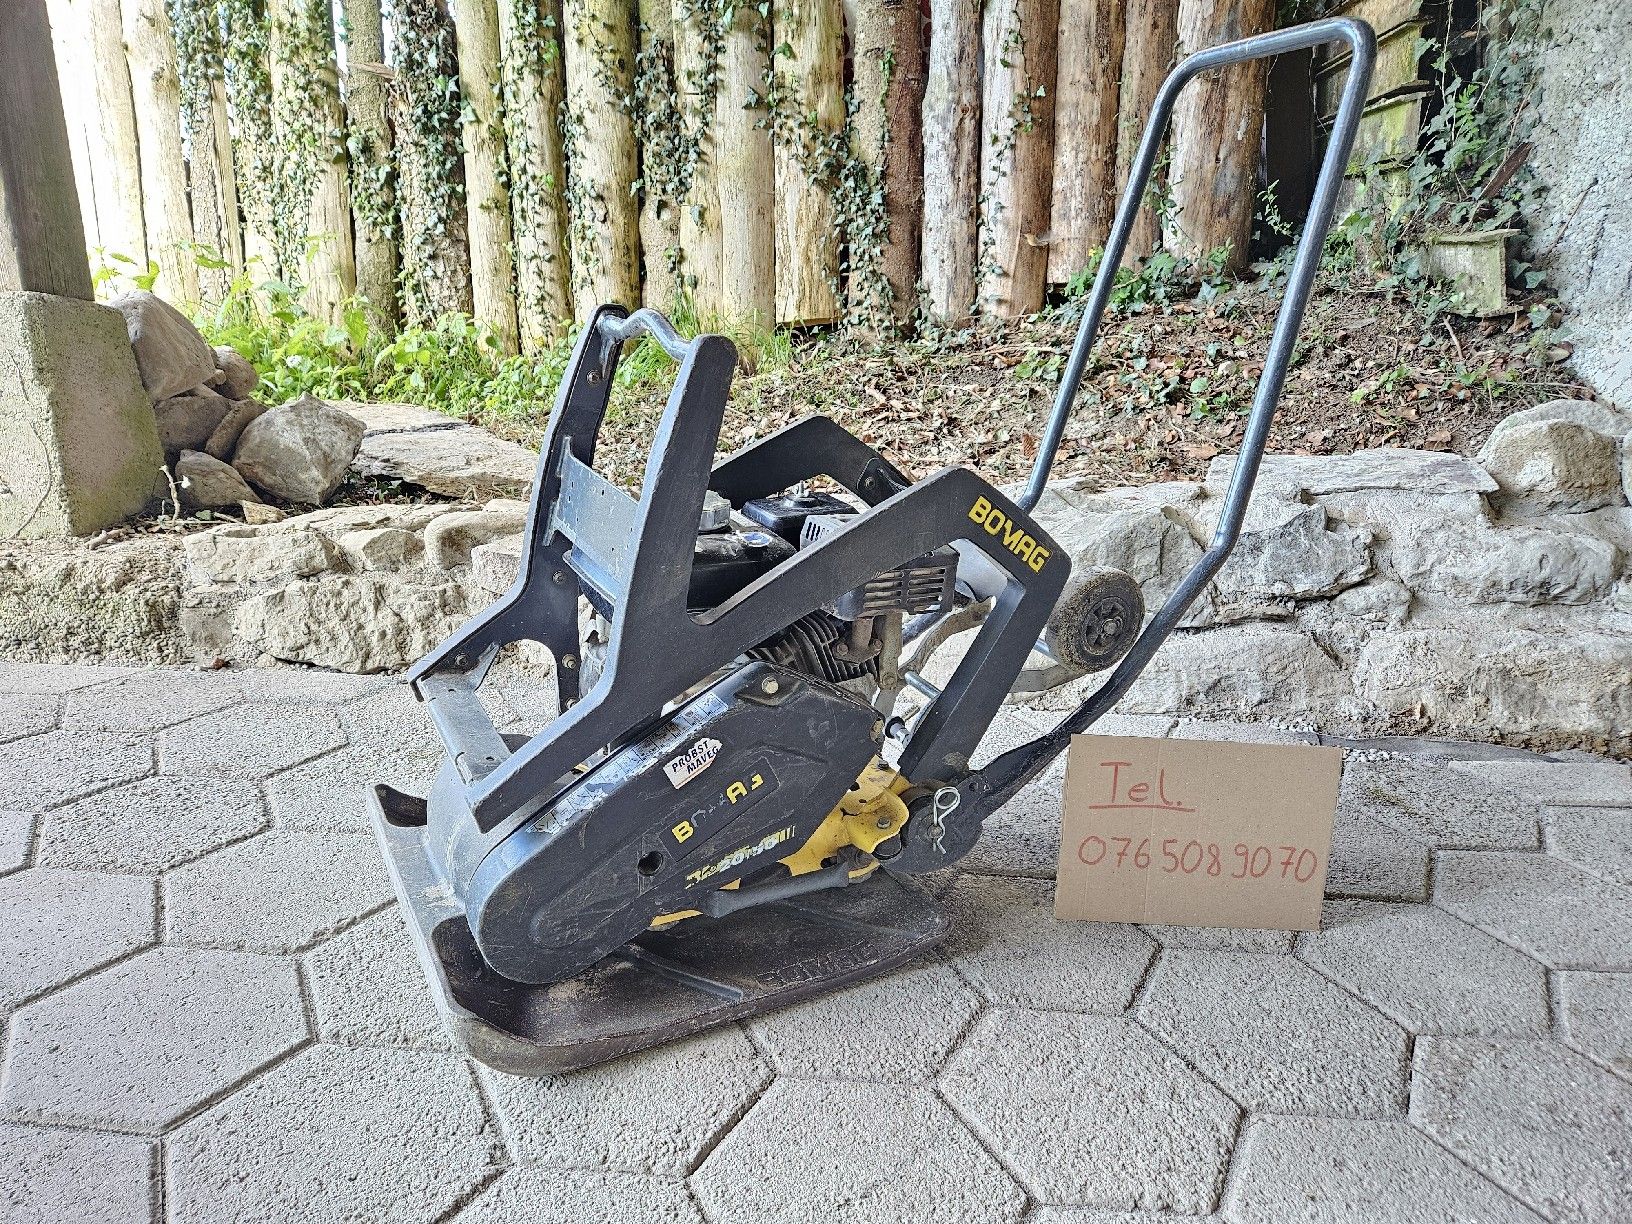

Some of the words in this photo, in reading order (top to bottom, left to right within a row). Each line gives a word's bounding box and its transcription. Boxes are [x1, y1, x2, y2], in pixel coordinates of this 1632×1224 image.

[968, 496, 1050, 573] BOMAG
[672, 740, 709, 772] PROBST
[686, 746, 720, 774] MAVEG
[1100, 761, 1183, 806] Tel.
